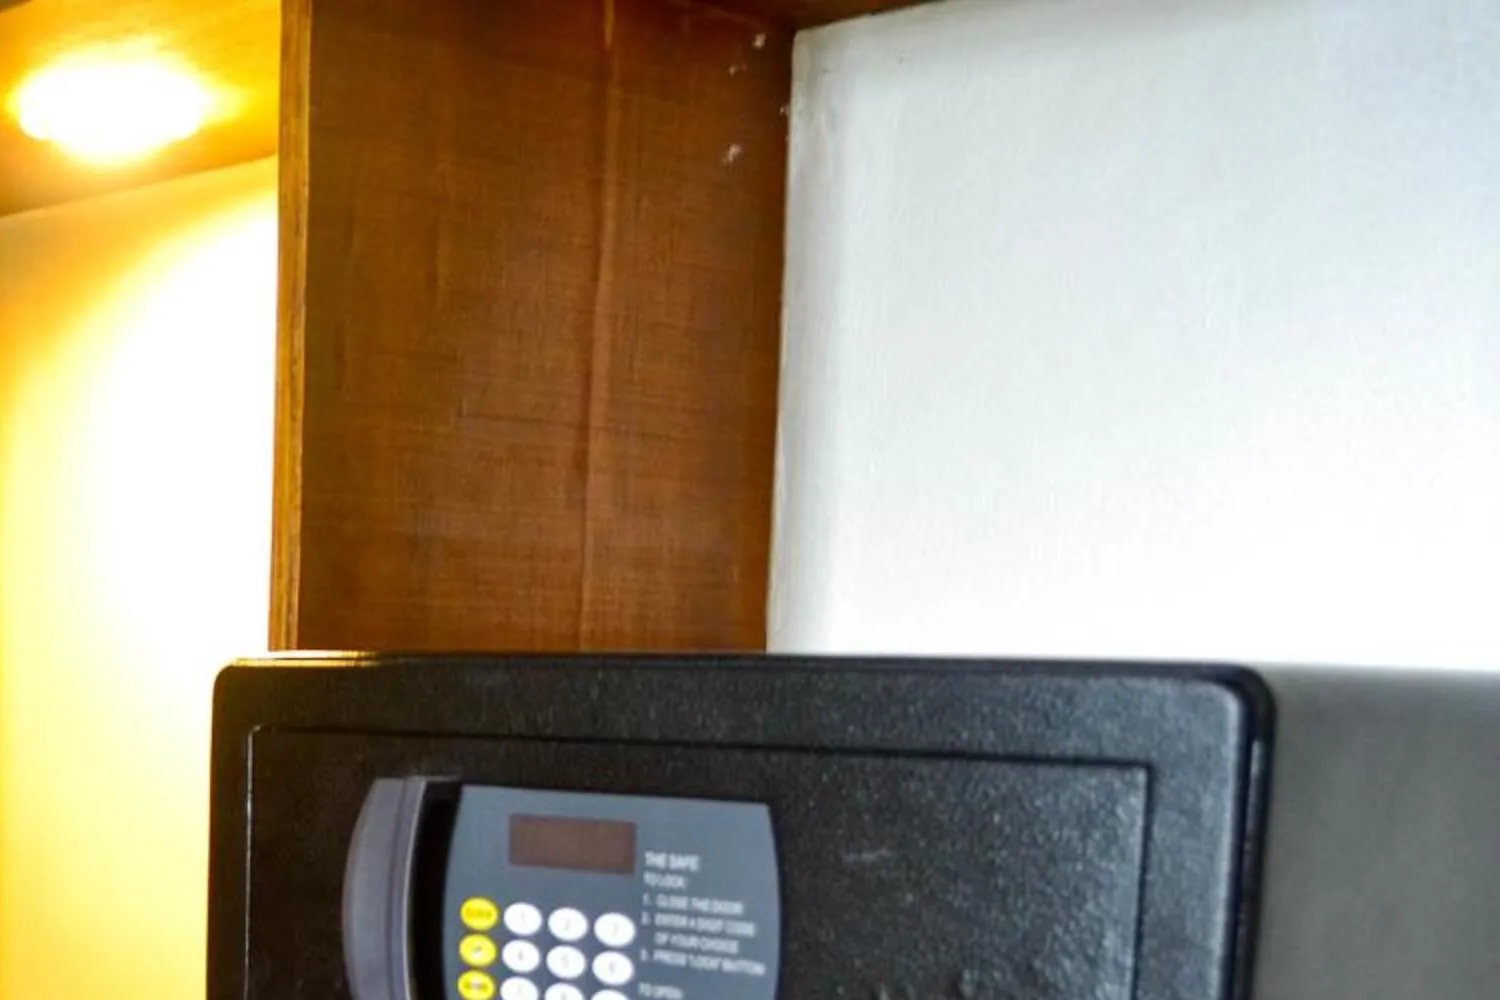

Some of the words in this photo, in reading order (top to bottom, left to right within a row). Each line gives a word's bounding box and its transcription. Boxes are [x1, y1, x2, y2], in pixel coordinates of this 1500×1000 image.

[644, 850, 667, 869] THE
[668, 853, 700, 872] SAFE
[690, 897, 710, 912] THE
[638, 982, 652, 997] TO
